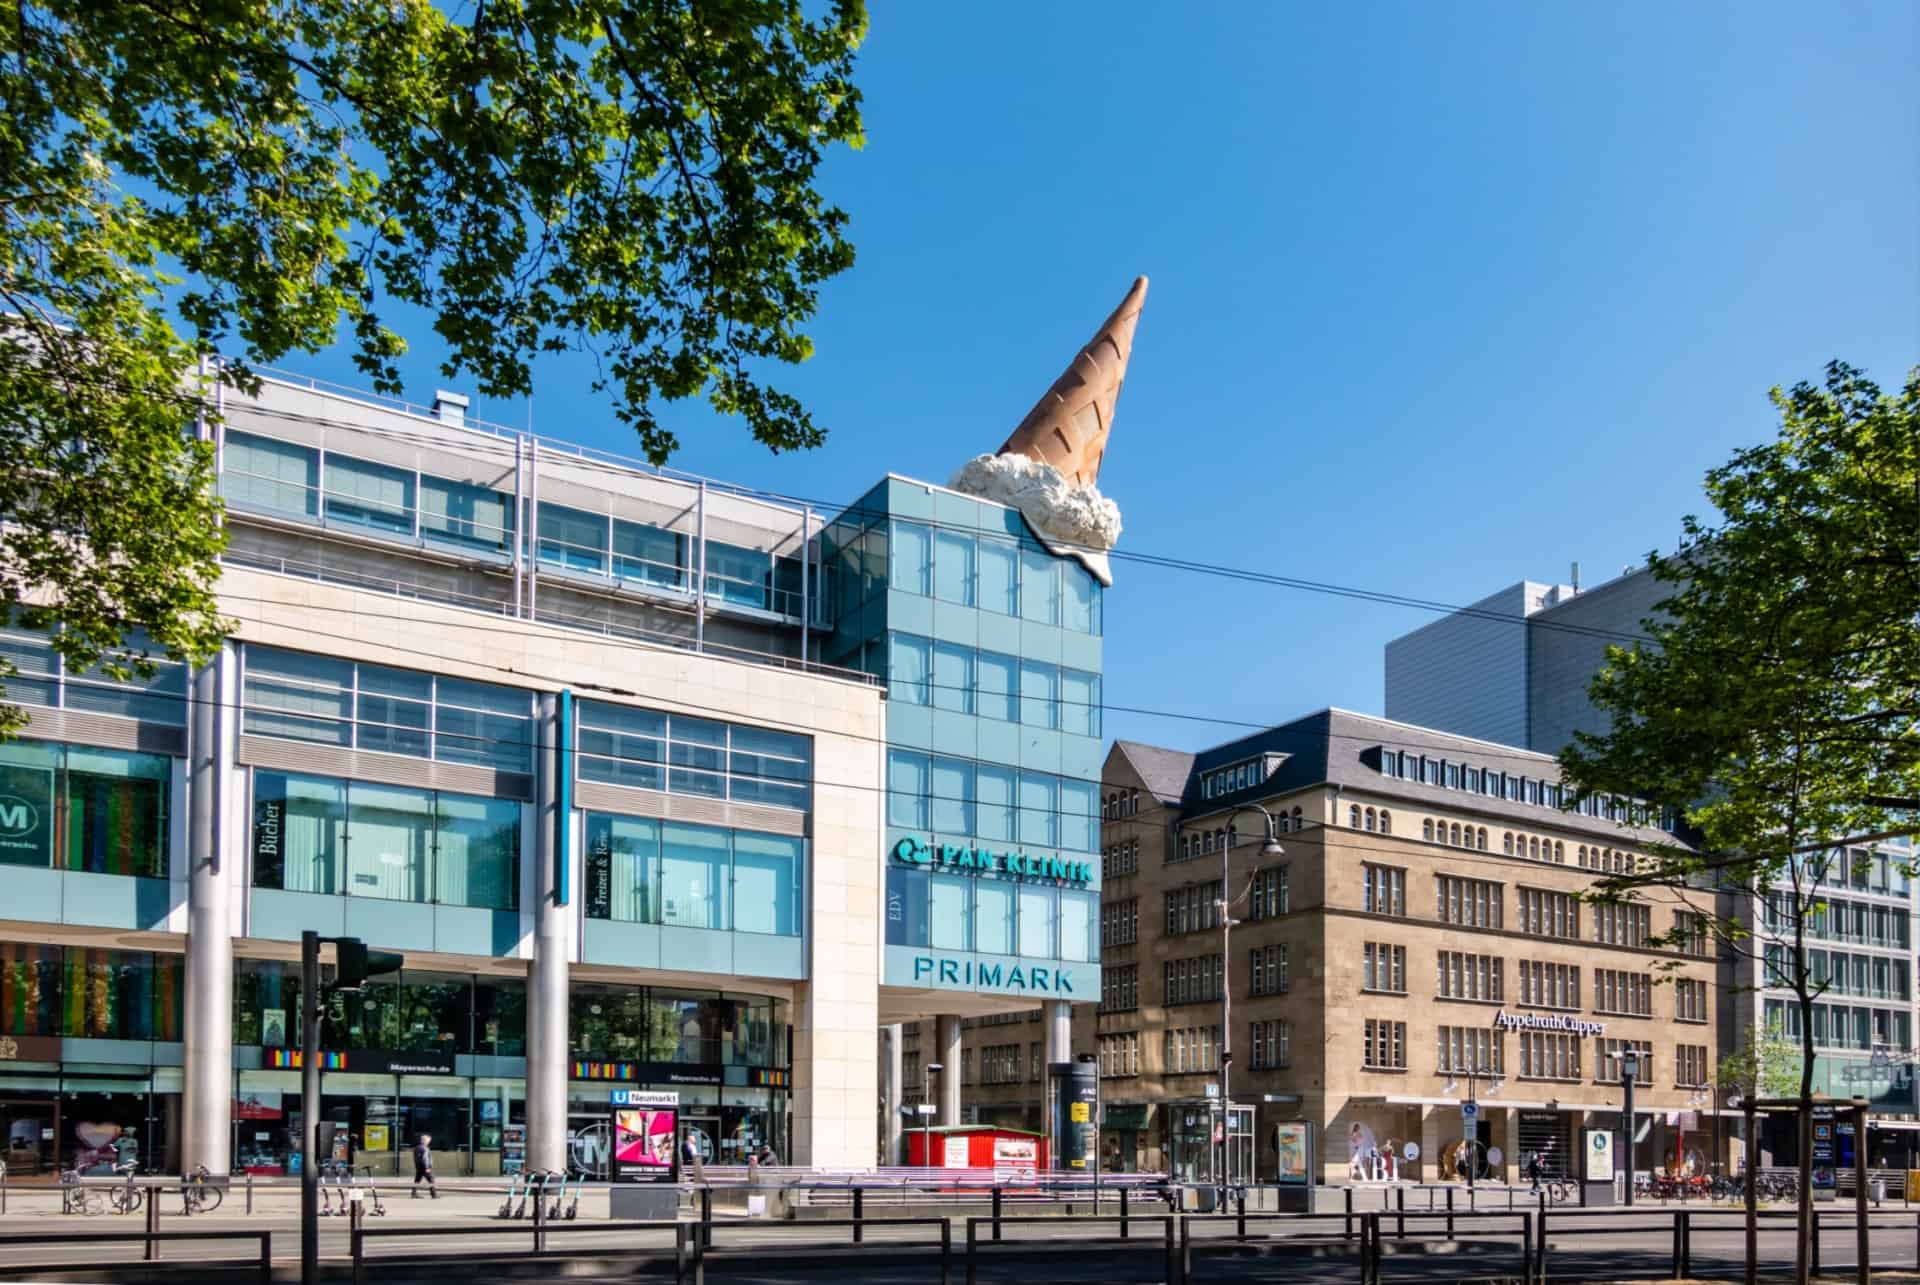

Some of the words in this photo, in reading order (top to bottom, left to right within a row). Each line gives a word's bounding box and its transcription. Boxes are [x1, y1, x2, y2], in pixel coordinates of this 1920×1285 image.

[258, 803, 280, 856] Bücher
[596, 858, 608, 867] &
[942, 843, 993, 868] PAN
[1007, 851, 1094, 881] KLINIK
[595, 869, 608, 905] Freizeit
[888, 889, 902, 920] EDV
[914, 956, 1074, 992] PRIMARK
[615, 1090, 627, 1103] U
[632, 1094, 676, 1102] Neumarkt
